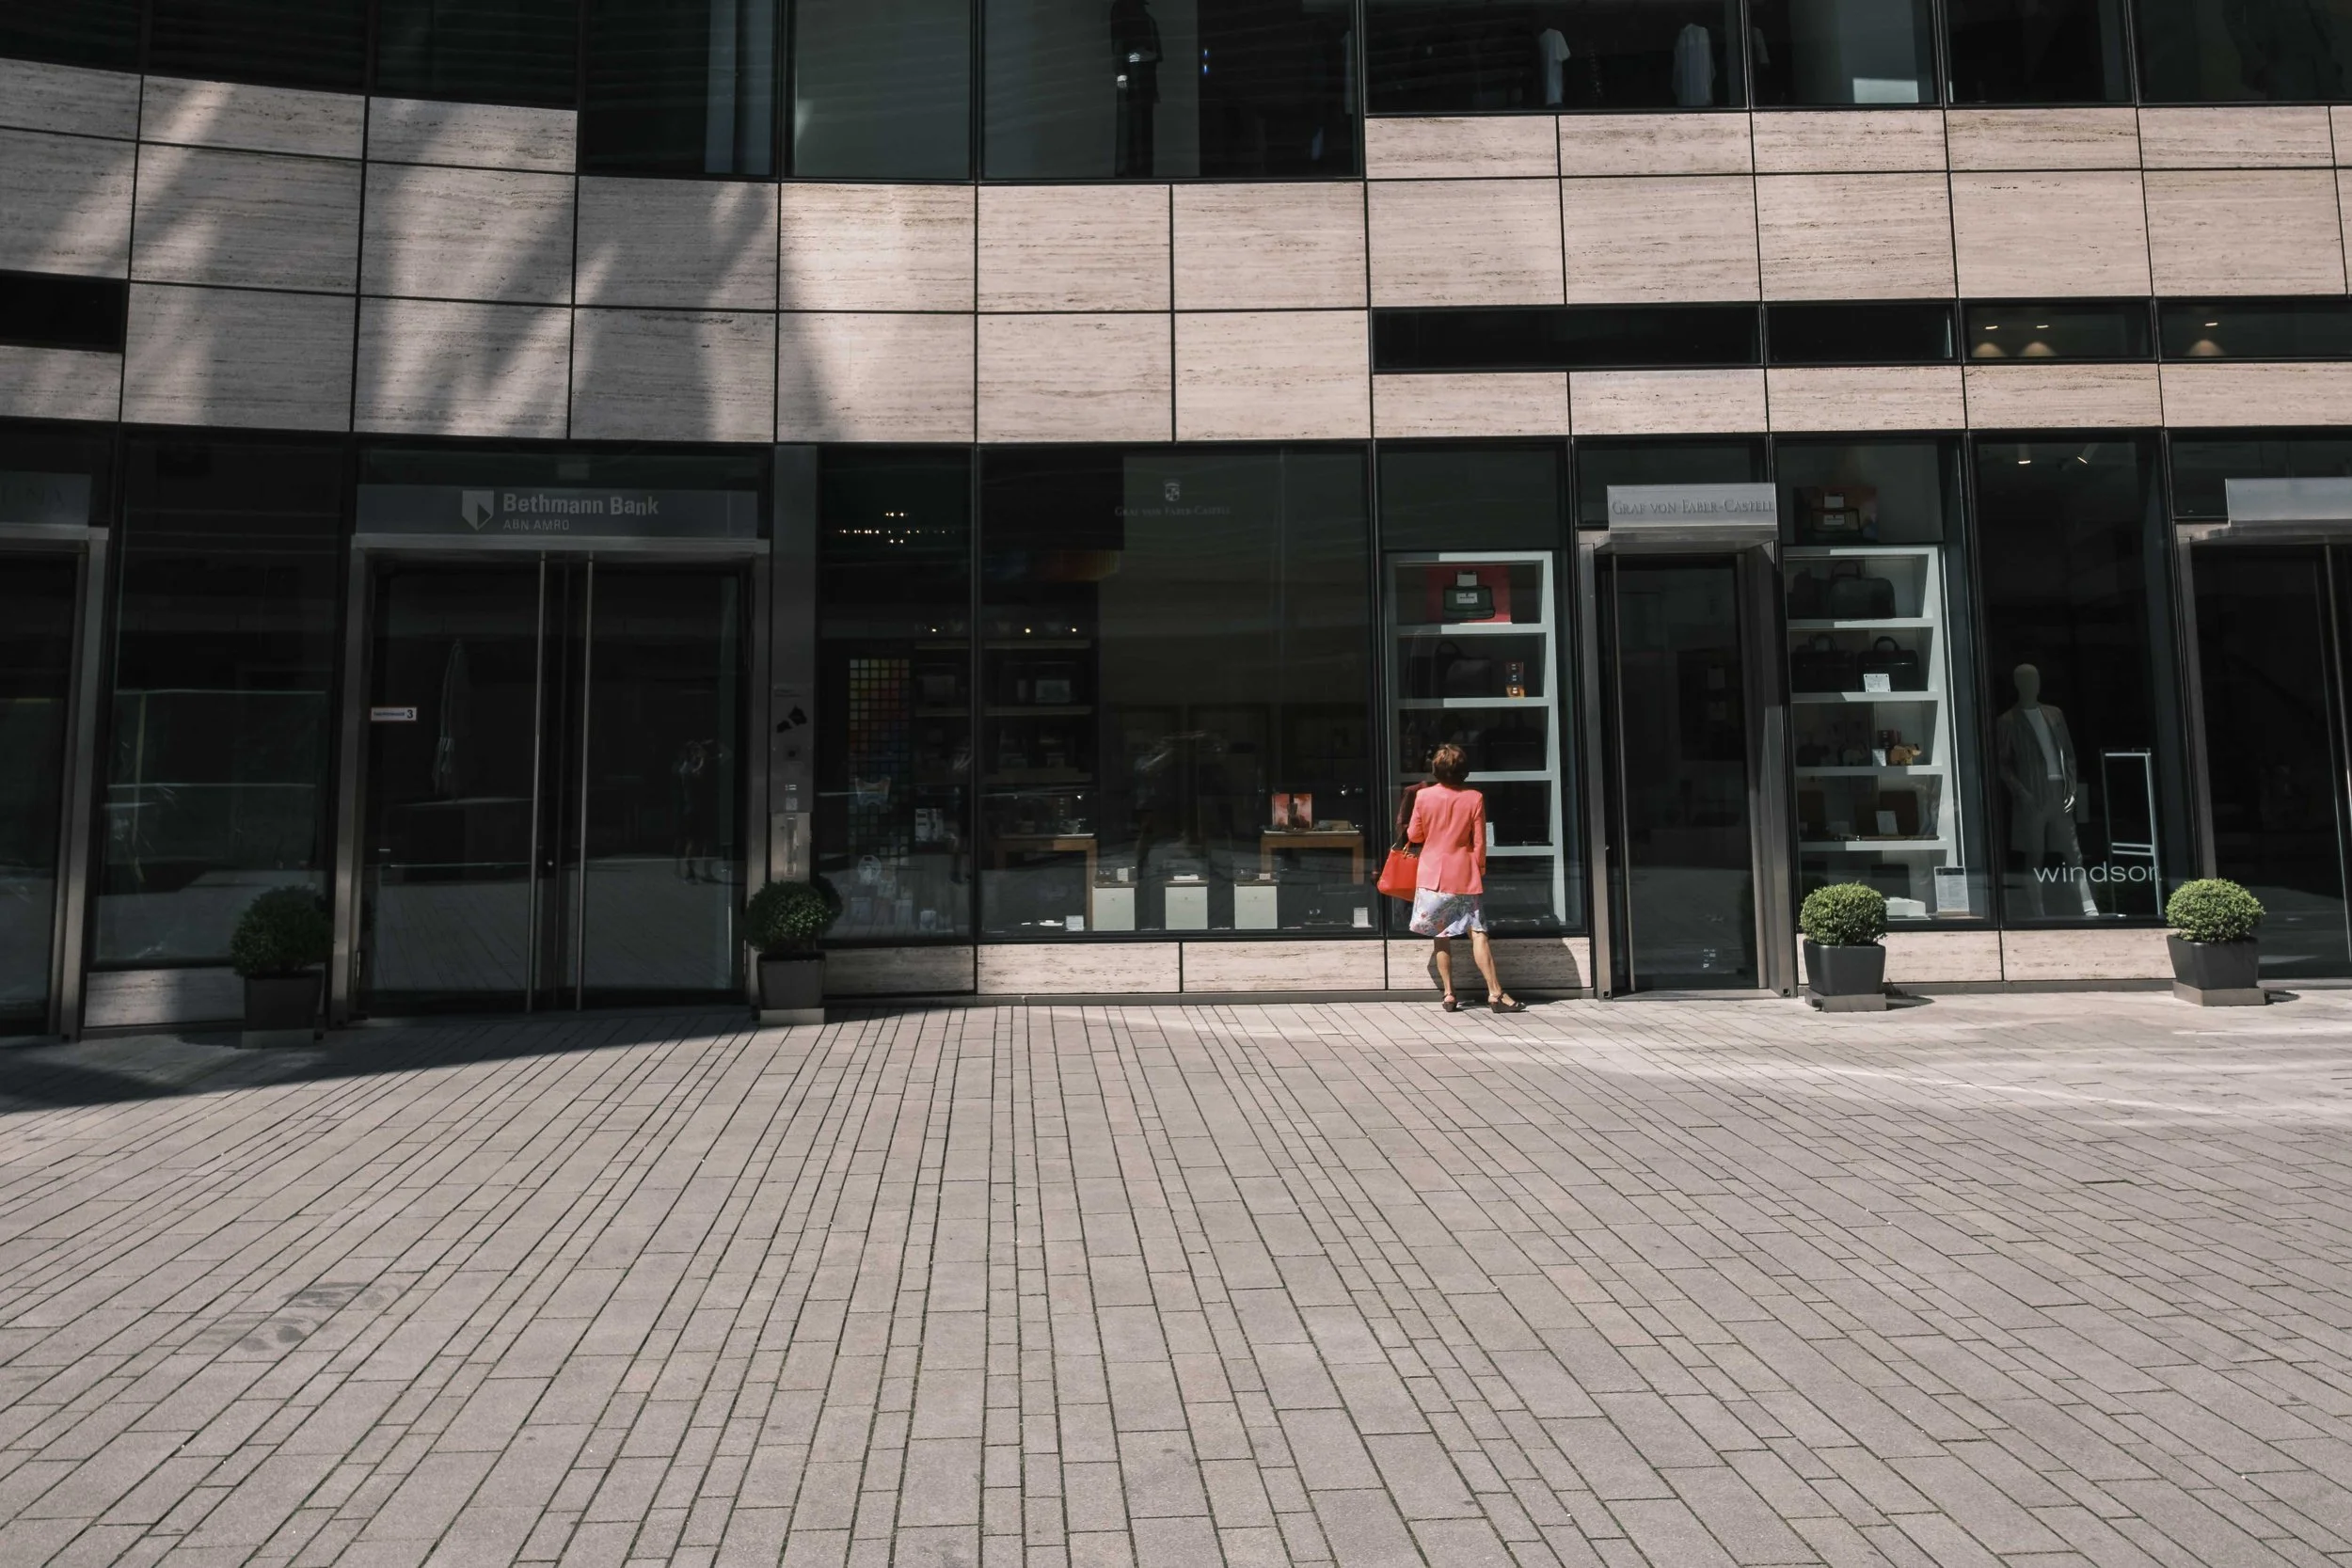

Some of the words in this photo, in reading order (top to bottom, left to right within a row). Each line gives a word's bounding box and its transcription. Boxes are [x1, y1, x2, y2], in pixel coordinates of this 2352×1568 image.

[503, 493, 604, 515] Bethmann
[610, 496, 660, 516] Bank
[1612, 500, 1646, 515] GRAF
[503, 518, 529, 531] ABN
[533, 519, 570, 531] AMRO
[406, 709, 413, 719] 3
